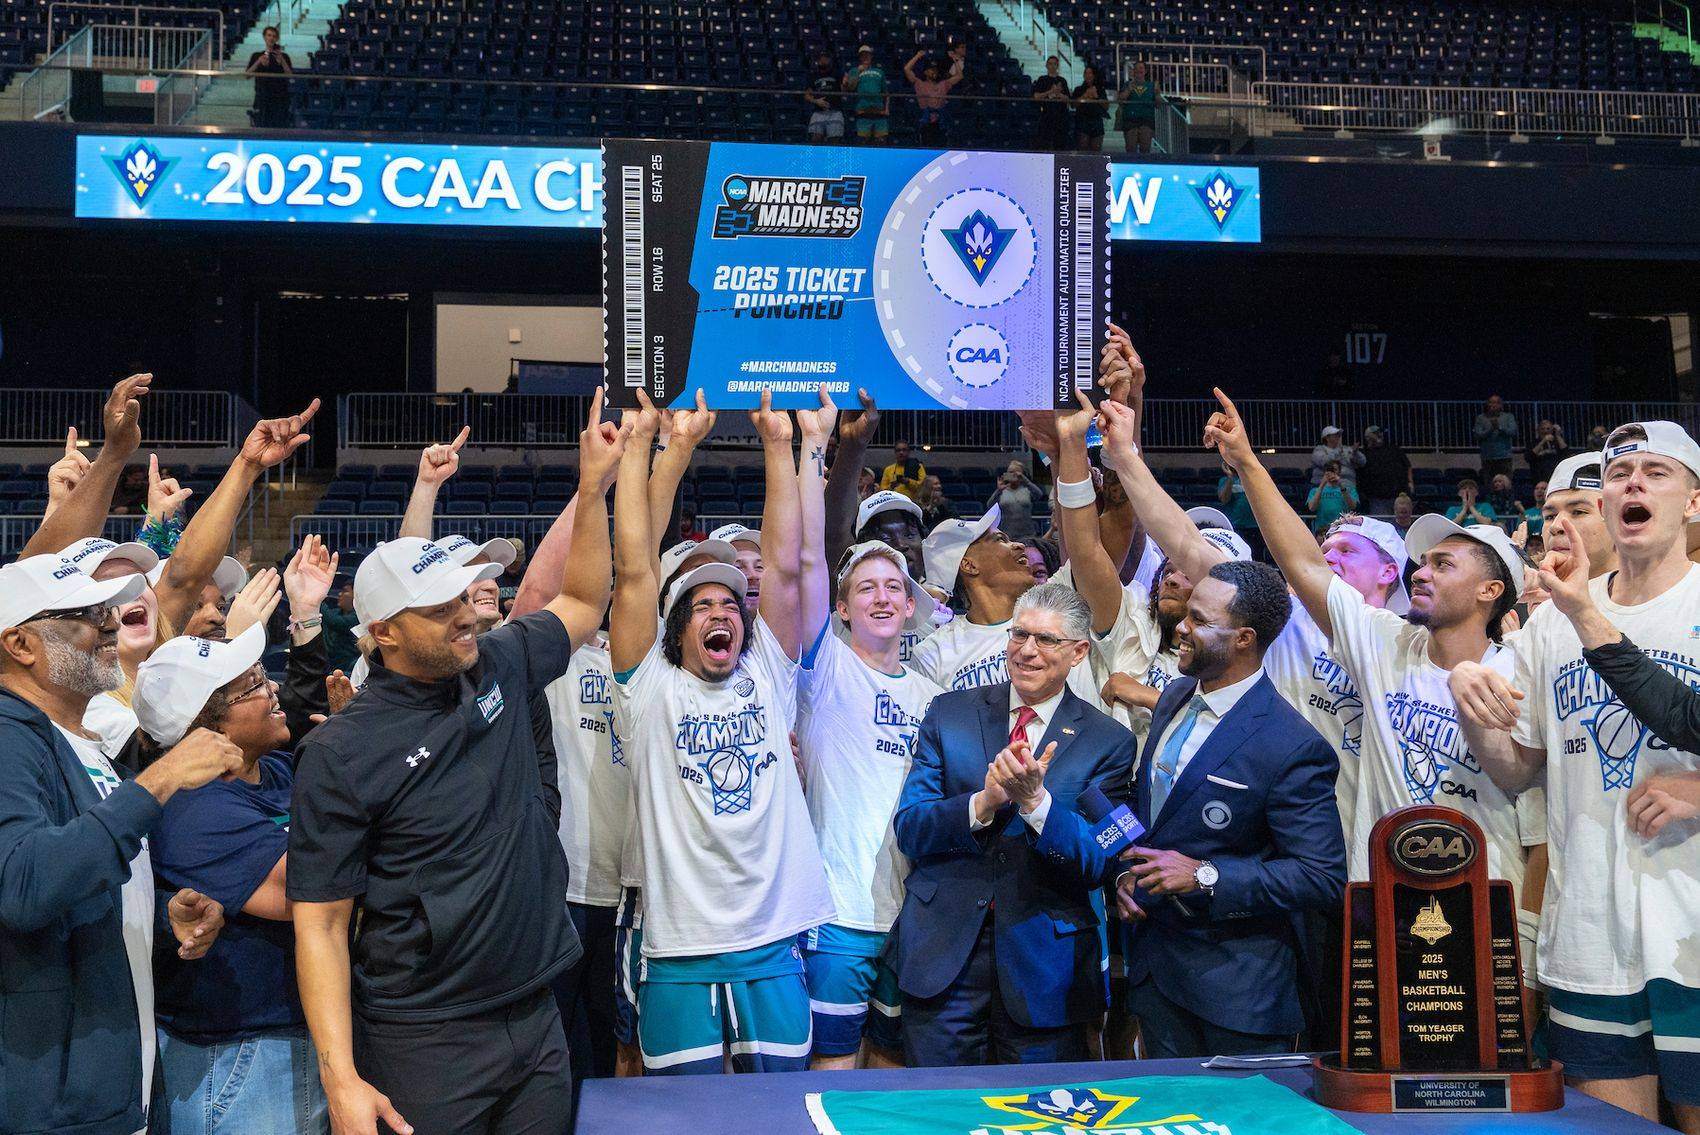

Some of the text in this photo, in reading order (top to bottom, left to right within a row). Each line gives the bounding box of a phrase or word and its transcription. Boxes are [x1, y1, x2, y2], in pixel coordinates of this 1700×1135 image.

[205, 152, 362, 207] 2025
[381, 159, 522, 211] CAA
[651, 154, 663, 203] SEAT 25
[748, 181, 826, 205] MARCH
[757, 206, 860, 228] MADNESS
[652, 247, 664, 292] ROW 16
[713, 265, 867, 293] 2025 TICKET
[1058, 167, 1070, 402] NCAA TOURNAMENT AUTOMATIC QUALIFIER
[733, 293, 844, 320] PUNCHED
[955, 347, 1002, 364] CAA
[1345, 333, 1388, 364] 107
[653, 335, 665, 398] SECTION 3
[740, 360, 837, 373] #MARCHMADNESS
[1308, 694, 1338, 716] 2025
[579, 717, 606, 734] 2025
[876, 739, 906, 757] 2025
[1440, 779, 1478, 803] CAA
[1101, 823, 1119, 839] CBS
[1101, 830, 1123, 850] SPORTS
[1401, 835, 1467, 861] CAA
[1421, 953, 1443, 964] 2025
[1418, 969, 1448, 980] MEN'S
[1403, 985, 1465, 996] BASKETBALL
[1406, 1001, 1463, 1012] CHAMPIONS
[1407, 1023, 1465, 1033] TOM YEAGER
[1419, 1033, 1454, 1043] TROPHY
[1414, 1090, 1486, 1098] NORTH CAROLINA
[1420, 1081, 1480, 1090] UNIVERSITY OF
[1425, 1098, 1476, 1107] WILMINGTON
